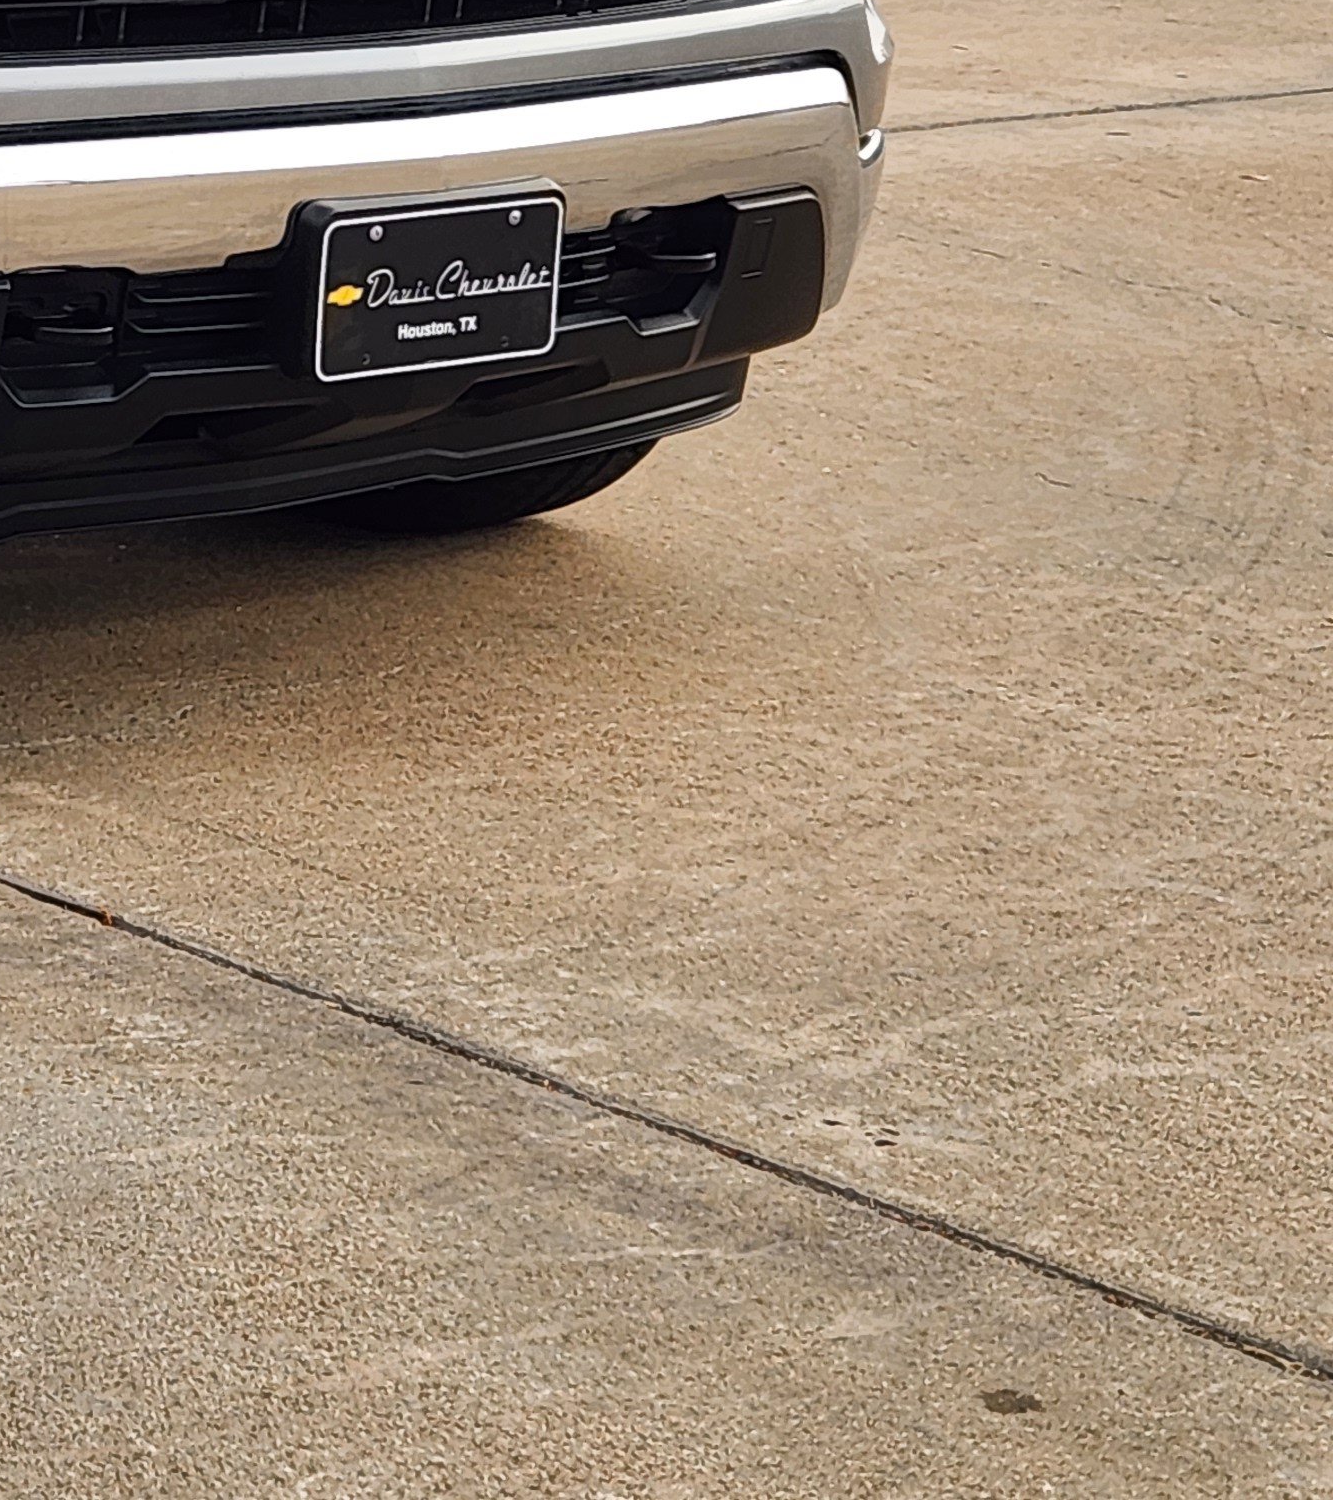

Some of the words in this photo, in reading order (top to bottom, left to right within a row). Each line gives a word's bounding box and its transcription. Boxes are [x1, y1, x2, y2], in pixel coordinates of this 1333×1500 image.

[367, 269, 434, 308] Davis
[435, 260, 552, 301] Chevrolet
[397, 320, 456, 340] Houston,
[458, 315, 477, 332] TX
